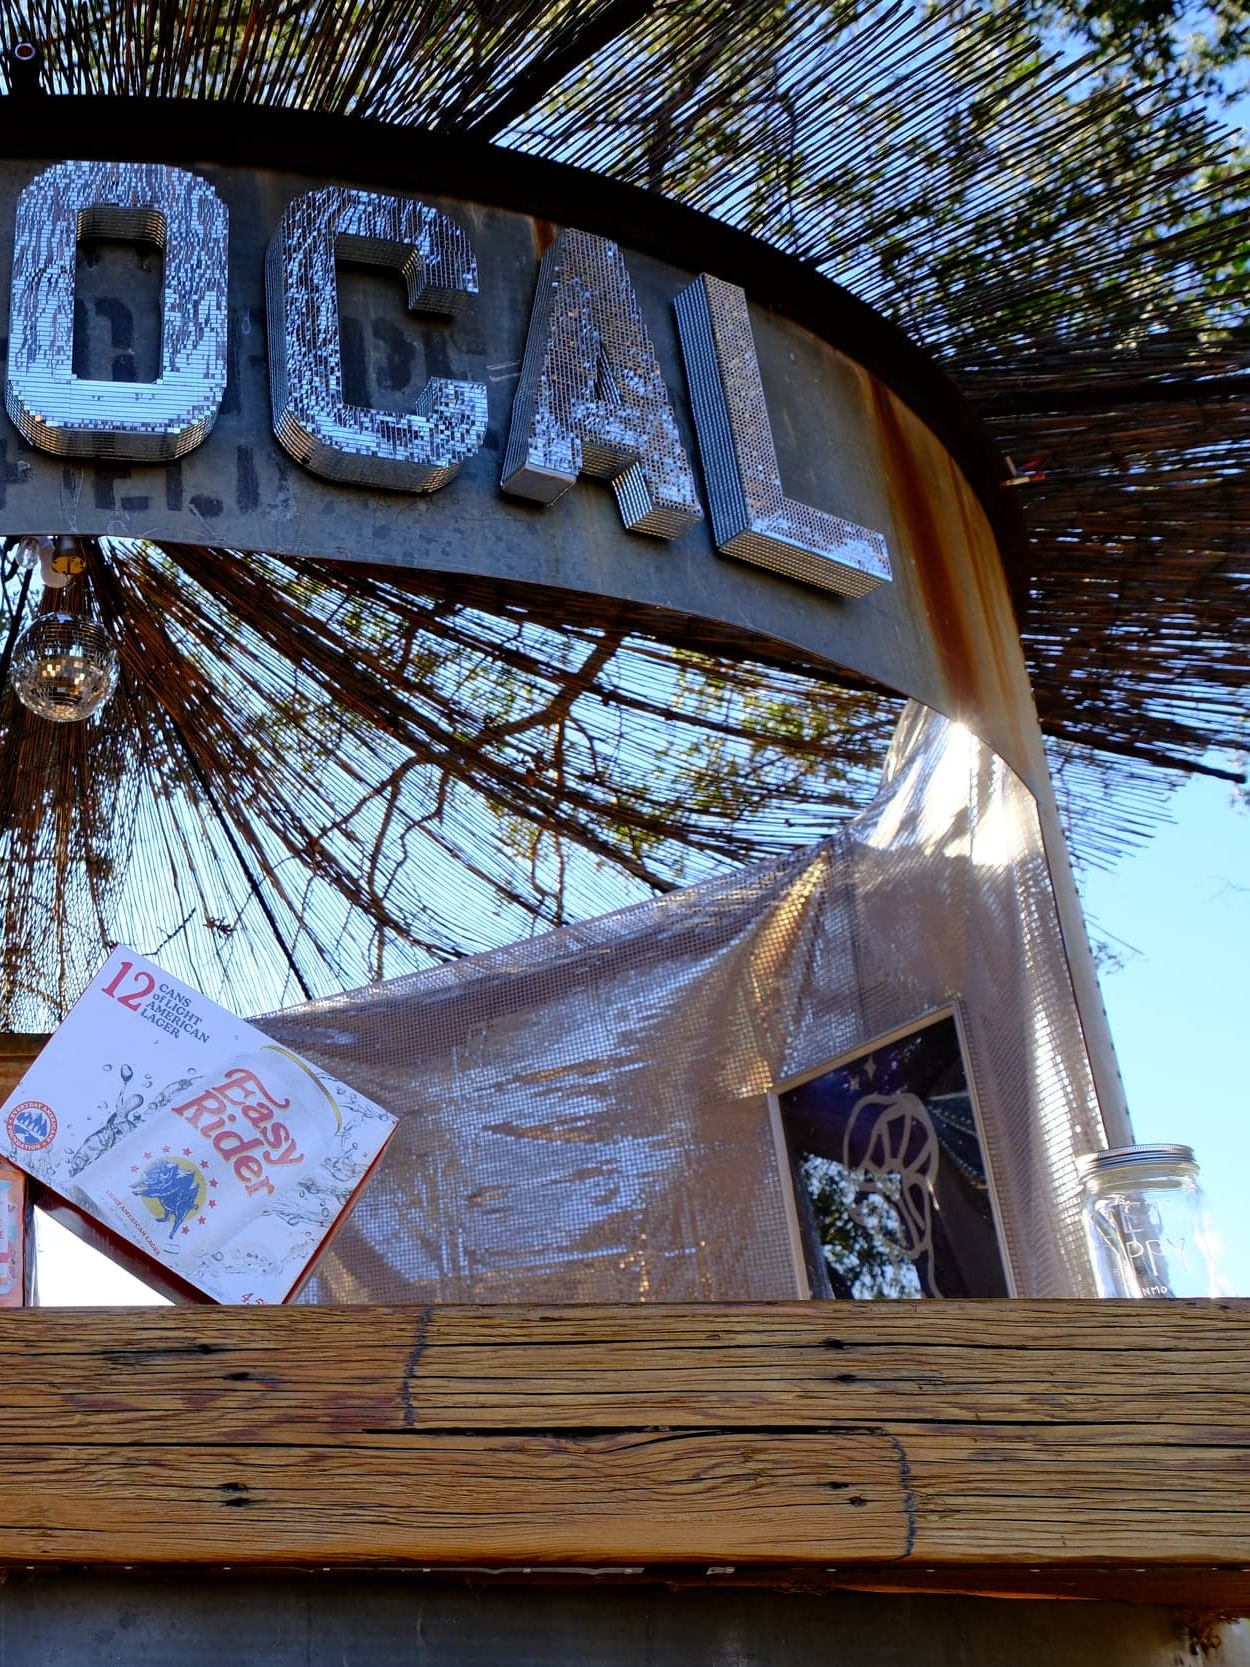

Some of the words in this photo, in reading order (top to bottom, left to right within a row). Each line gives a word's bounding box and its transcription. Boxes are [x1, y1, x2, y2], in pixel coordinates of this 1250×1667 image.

[101, 961, 156, 1013] 12
[152, 993, 167, 1005] of
[164, 1001, 203, 1026] LIGHT
[159, 983, 192, 1008] CANS
[140, 1008, 181, 1039] LAGER
[146, 1001, 210, 1043] AMERICAN
[211, 1068, 305, 1166] Easy
[171, 1088, 276, 1198] Rider
[119, 1204, 146, 1237] AMERICAN
[144, 1235, 162, 1256] LAGER
